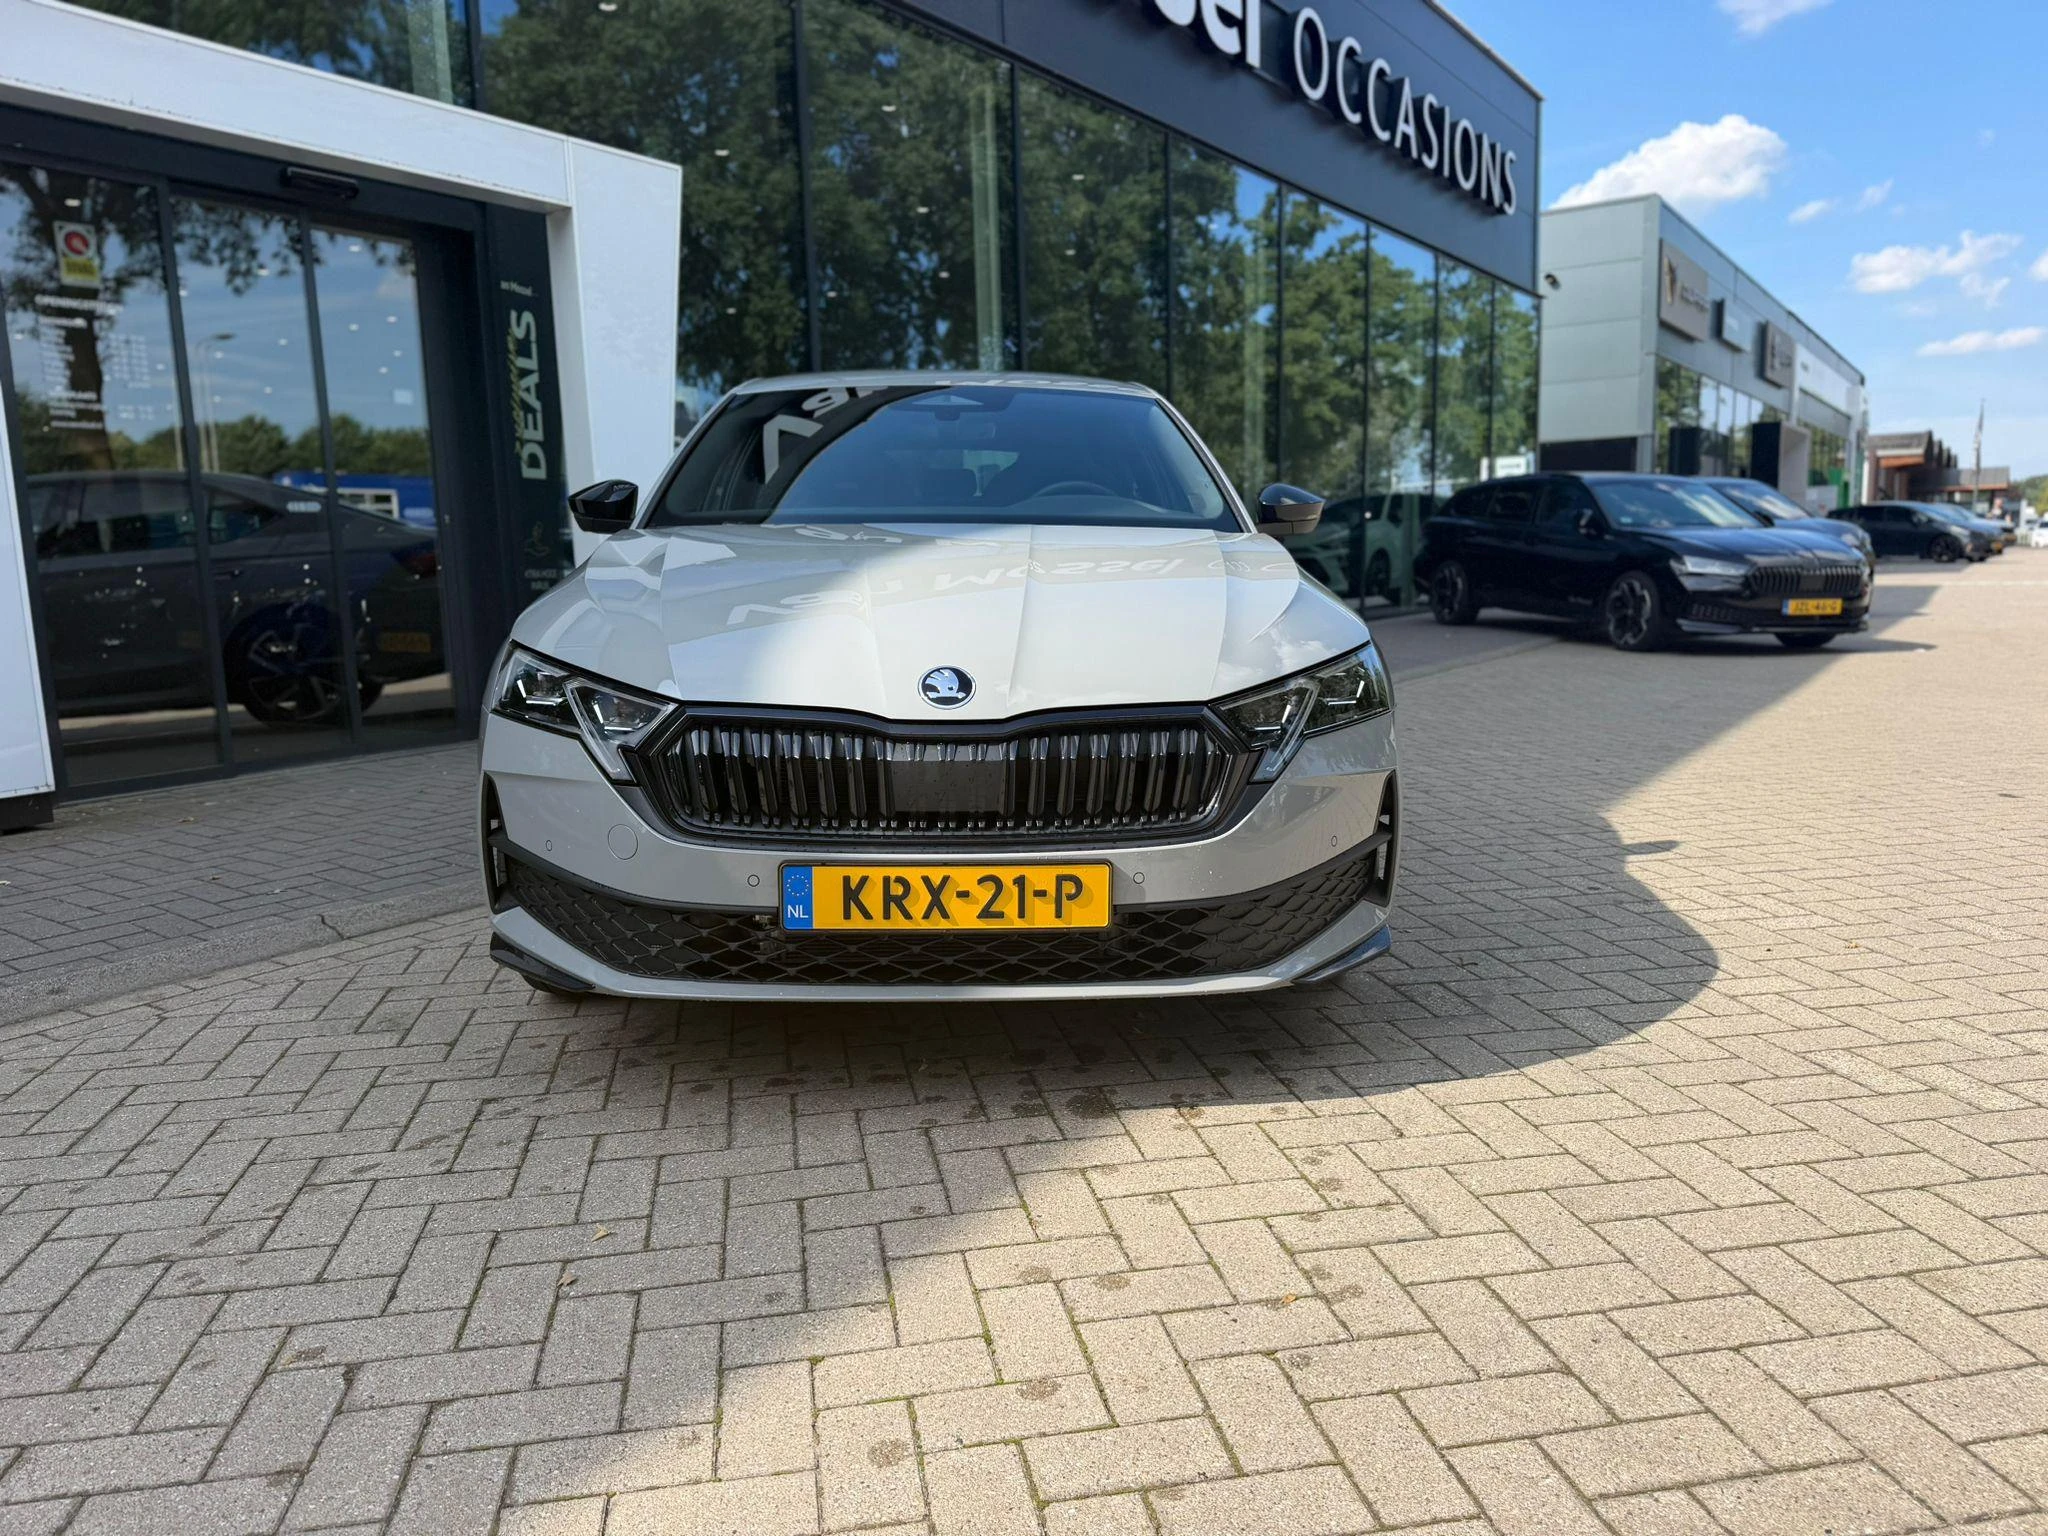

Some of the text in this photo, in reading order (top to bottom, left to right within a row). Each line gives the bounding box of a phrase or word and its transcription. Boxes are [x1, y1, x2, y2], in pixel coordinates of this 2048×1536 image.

[1294, 7, 1516, 216] OCCASIONS
[510, 309, 547, 480] DEALS
[787, 874, 1084, 921] NL KRX-21-P
